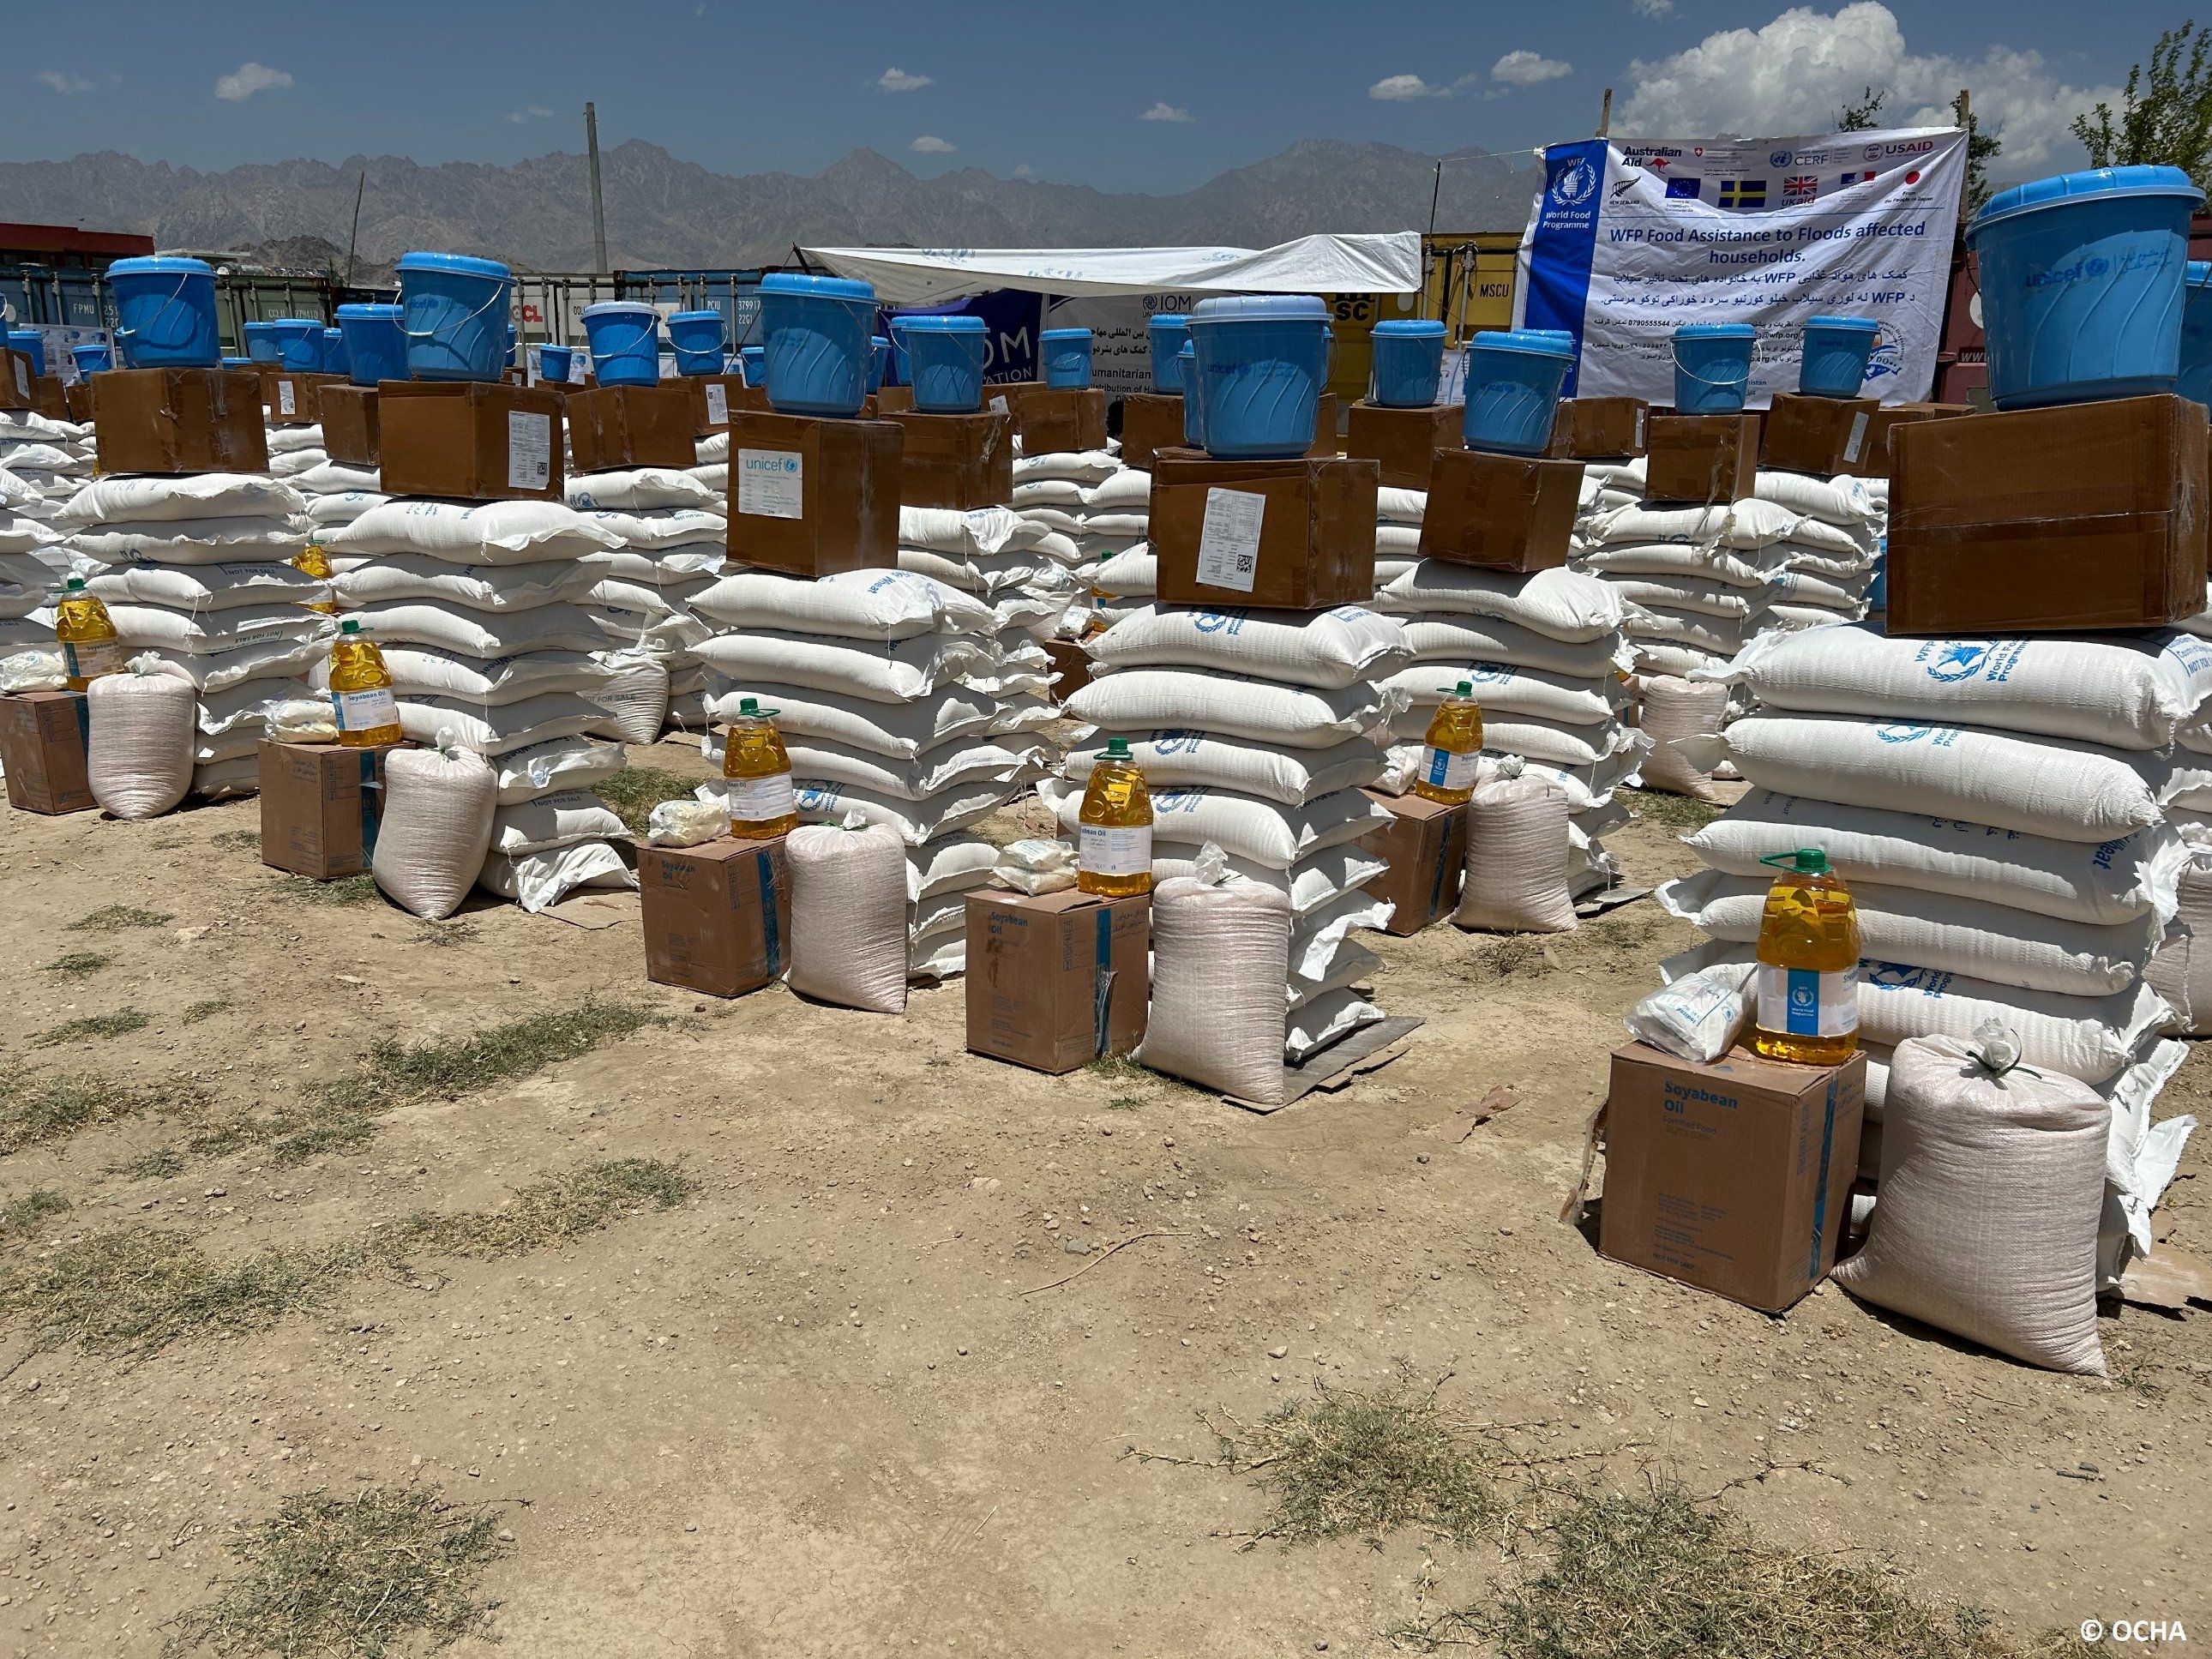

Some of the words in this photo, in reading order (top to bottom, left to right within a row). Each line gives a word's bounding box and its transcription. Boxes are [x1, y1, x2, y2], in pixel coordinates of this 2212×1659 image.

[1622, 146, 1682, 158] Australian
[1886, 141, 1933, 153] USAID
[1620, 157, 1643, 167] Aid
[1794, 154, 1829, 166] CERF
[1542, 221, 1590, 230] Programme
[1610, 229, 1644, 243] WFP
[1647, 228, 1685, 243] Food
[1688, 228, 1771, 243] Assistance
[1776, 229, 1793, 242] to
[1798, 225, 1851, 241] Floods
[1855, 221, 1926, 237] affected
[1709, 249, 1806, 264] households.
[1668, 274, 1688, 283] تحت
[1692, 273, 1710, 285] های
[1713, 273, 1747, 286] خانواده
[1764, 272, 1796, 284] WFP
[1831, 271, 1854, 282] مواد
[1857, 271, 1877, 281] های
[1882, 269, 1908, 280] کمک
[2025, 262, 2085, 288] unicef
[1479, 283, 1510, 298] MSCU
[1160, 295, 1192, 311] IOM
[1872, 292, 1905, 304] WFP
[73, 304, 95, 315] FPMU
[707, 300, 720, 310] PCIU
[268, 309, 286, 317] CCLU
[295, 310, 319, 319] 279410
[738, 314, 753, 325] 22G1
[1091, 368, 1151, 380] umanitarian
[1207, 361, 1237, 375] unicef
[746, 456, 783, 472] unicef
[1914, 640, 1936, 663] WFP
[1986, 652, 2008, 682] World
[348, 693, 378, 702] Soyabean
[990, 911, 1029, 927] Soyabean
[991, 925, 1002, 935] Oil
[1664, 1080, 1738, 1109] Soyabean
[1664, 1099, 1684, 1115] Oil
